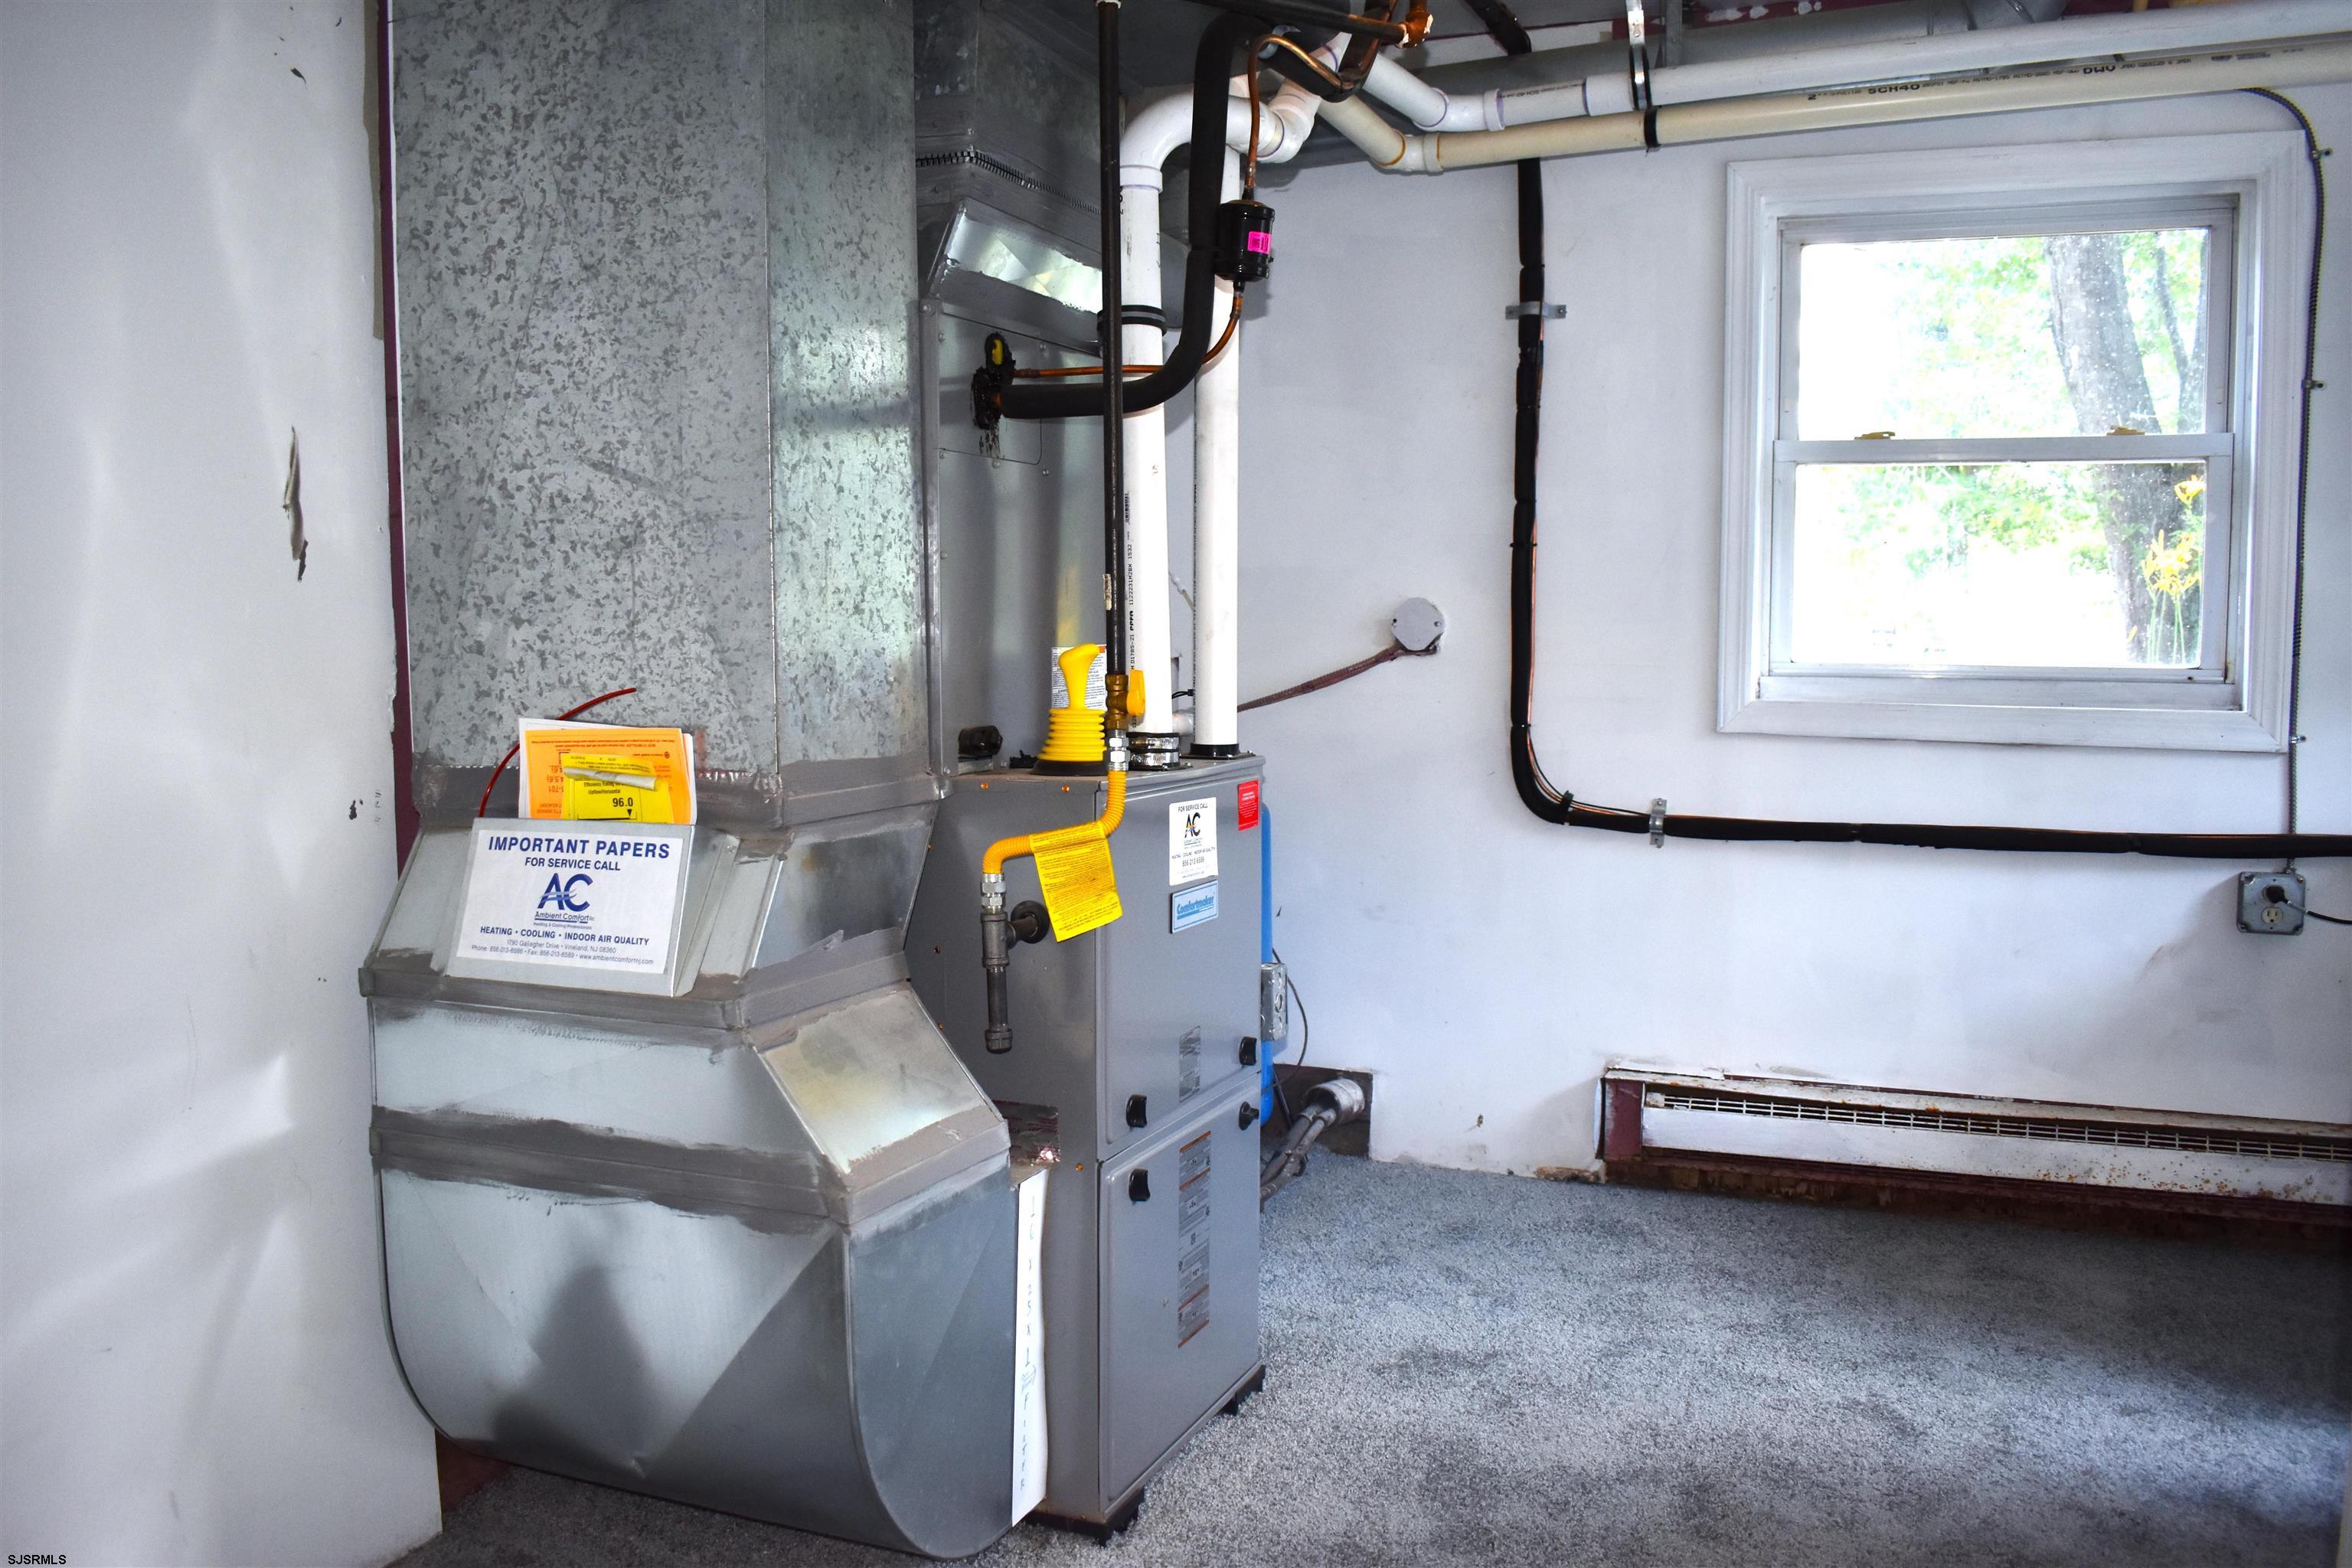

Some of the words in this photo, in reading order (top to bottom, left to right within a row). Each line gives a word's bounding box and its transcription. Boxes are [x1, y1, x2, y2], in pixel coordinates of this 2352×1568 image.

[1868, 83, 1920, 94] SCH40
[2083, 65, 2116, 74] DWV
[612, 797, 633, 808] 96.0
[1184, 812, 1200, 838] AC
[488, 837, 590, 854] IMPORTANT
[596, 841, 670, 859] PAPERS
[524, 857, 545, 867] FOR
[547, 858, 591, 869] SERVICE
[594, 861, 621, 871] CALL
[537, 873, 593, 912] AC
[1177, 895, 1214, 915] Comfortmaker
[534, 911, 562, 920] Ambient
[563, 913, 590, 922] Comfort
[480, 926, 513, 936] HEATING
[521, 929, 556, 939] COOLING
[564, 933, 596, 942] INDOOR
[614, 936, 649, 946] QUALITY
[519, 939, 545, 950] Gallagher
